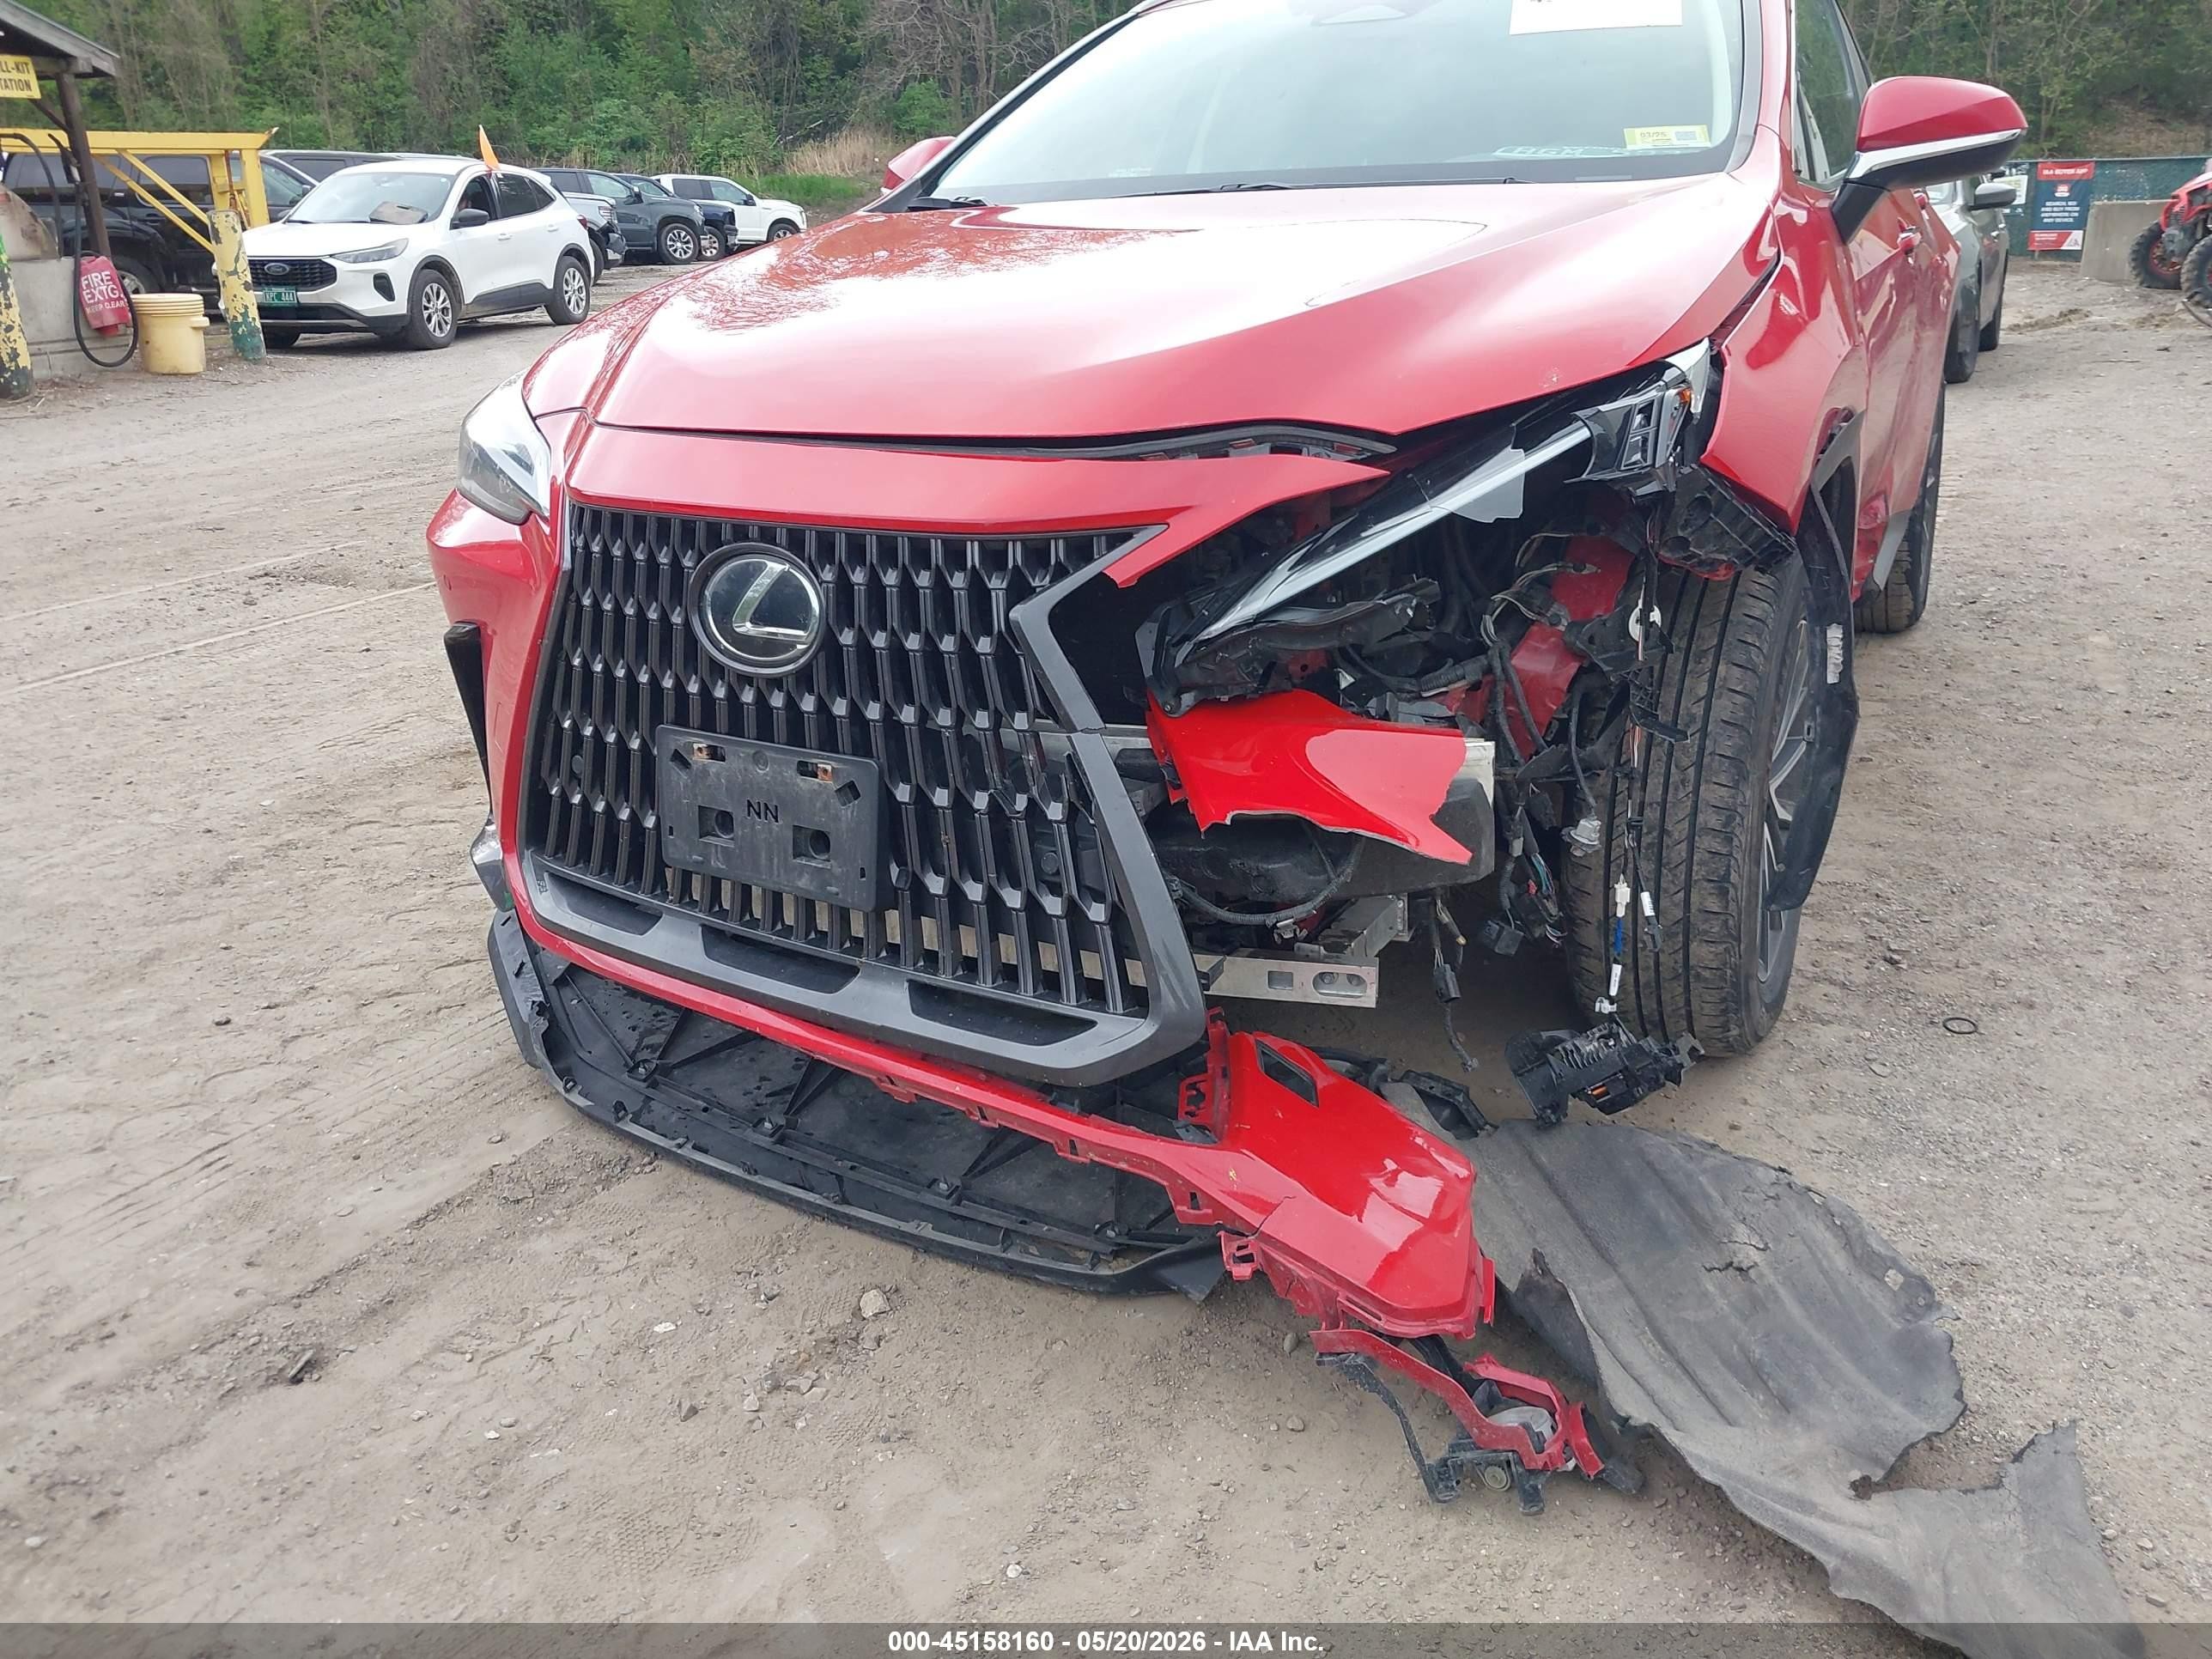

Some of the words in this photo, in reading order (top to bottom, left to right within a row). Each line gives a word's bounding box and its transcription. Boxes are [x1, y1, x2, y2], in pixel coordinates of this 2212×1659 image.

[81, 271, 112, 290] FIRE
[82, 285, 124, 304] EXTG.
[104, 301, 125, 309] CLEAR
[746, 799, 780, 824] NN
